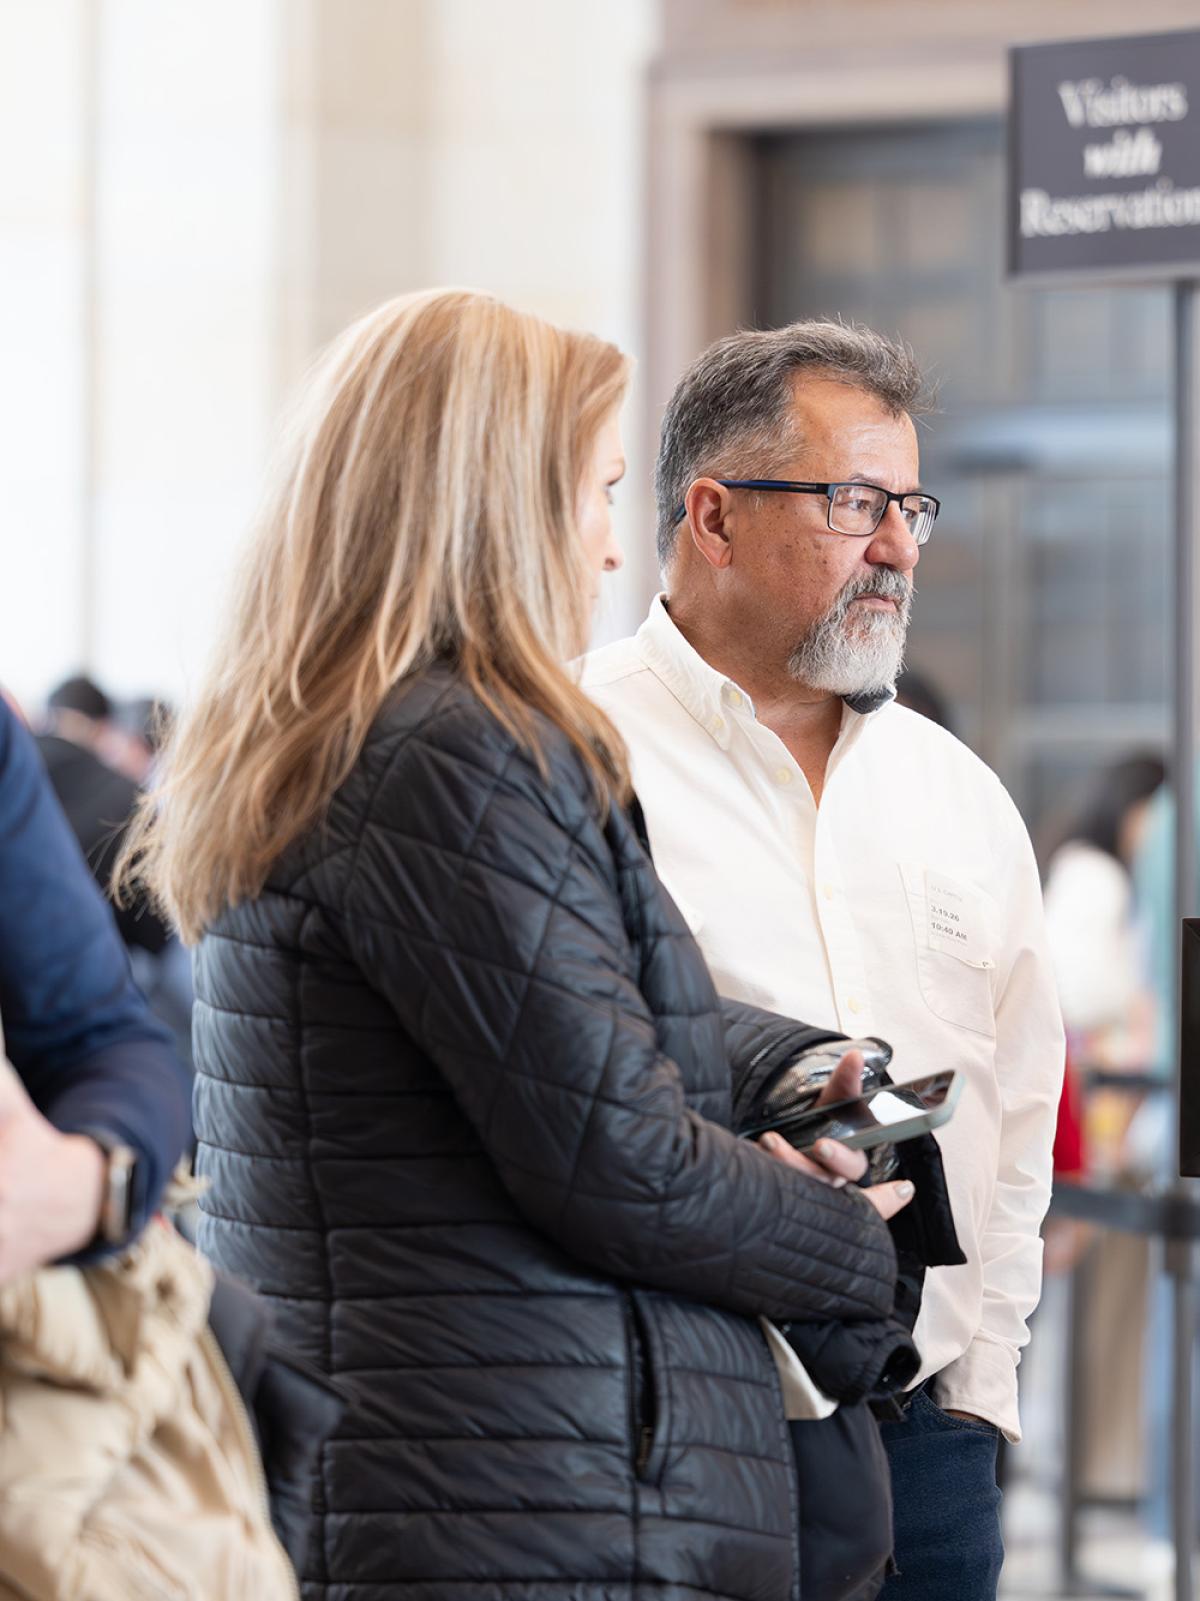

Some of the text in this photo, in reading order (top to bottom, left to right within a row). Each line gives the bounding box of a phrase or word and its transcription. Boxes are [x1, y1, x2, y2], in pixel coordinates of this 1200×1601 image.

[1057, 76, 1188, 128] Visitors
[1083, 128, 1162, 178] with
[931, 922, 954, 935] 10:40
[955, 931, 967, 941] AM
